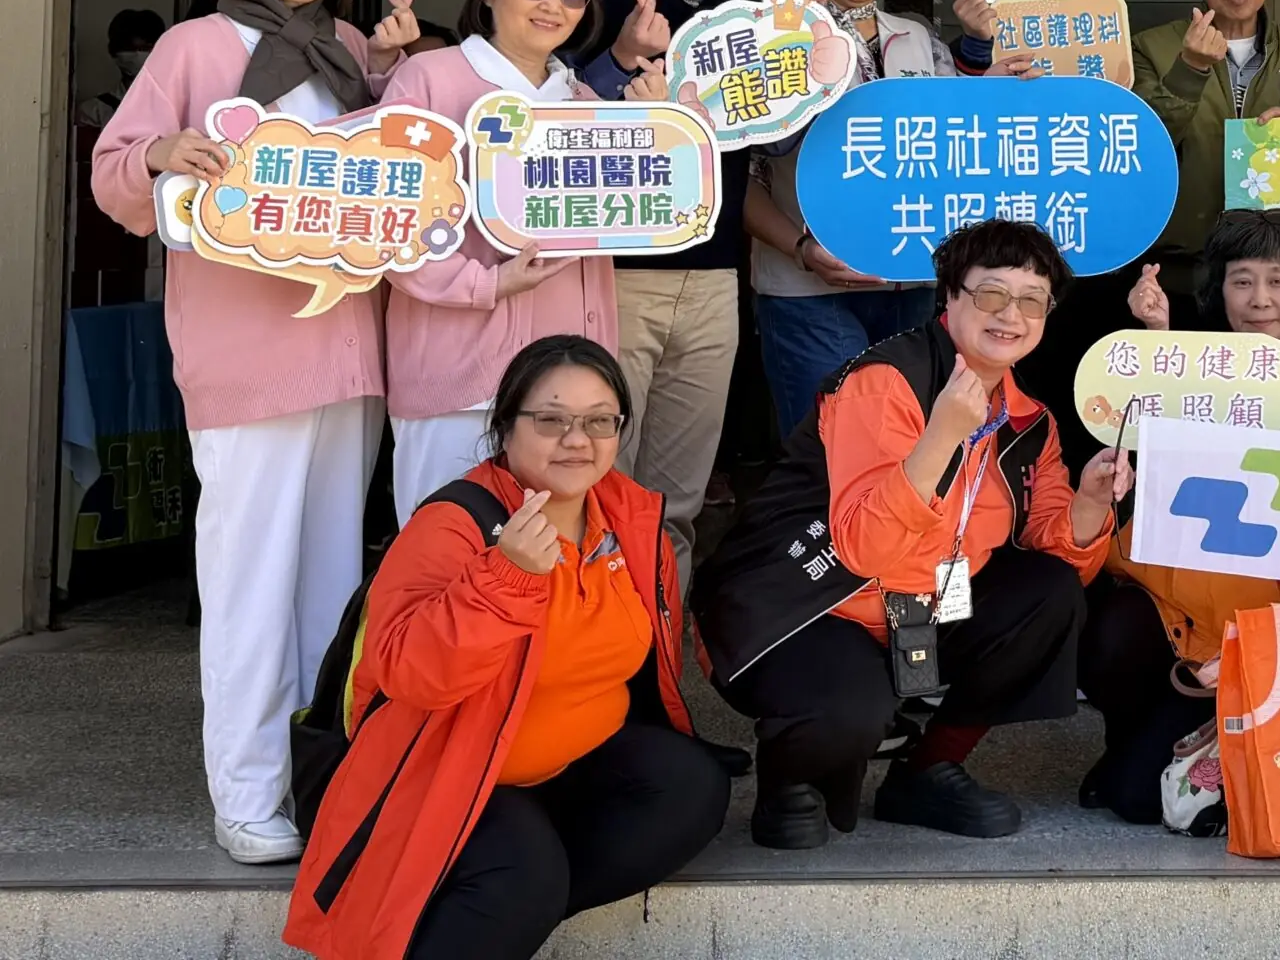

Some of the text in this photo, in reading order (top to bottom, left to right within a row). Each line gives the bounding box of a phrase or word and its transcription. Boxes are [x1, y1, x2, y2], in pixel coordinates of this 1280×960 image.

[995, 11, 1121, 51] 社區護理科
[691, 28, 761, 77] 新屋
[547, 128, 655, 150] 衛生福利部
[842, 112, 1143, 180] 長照社福資源
[254, 146, 422, 199] 新屋護理
[523, 154, 673, 189] 桃園醫院
[251, 193, 417, 244] 有您真好
[525, 193, 674, 229] 新屋分院
[1104, 341, 1280, 382] 您的健康
